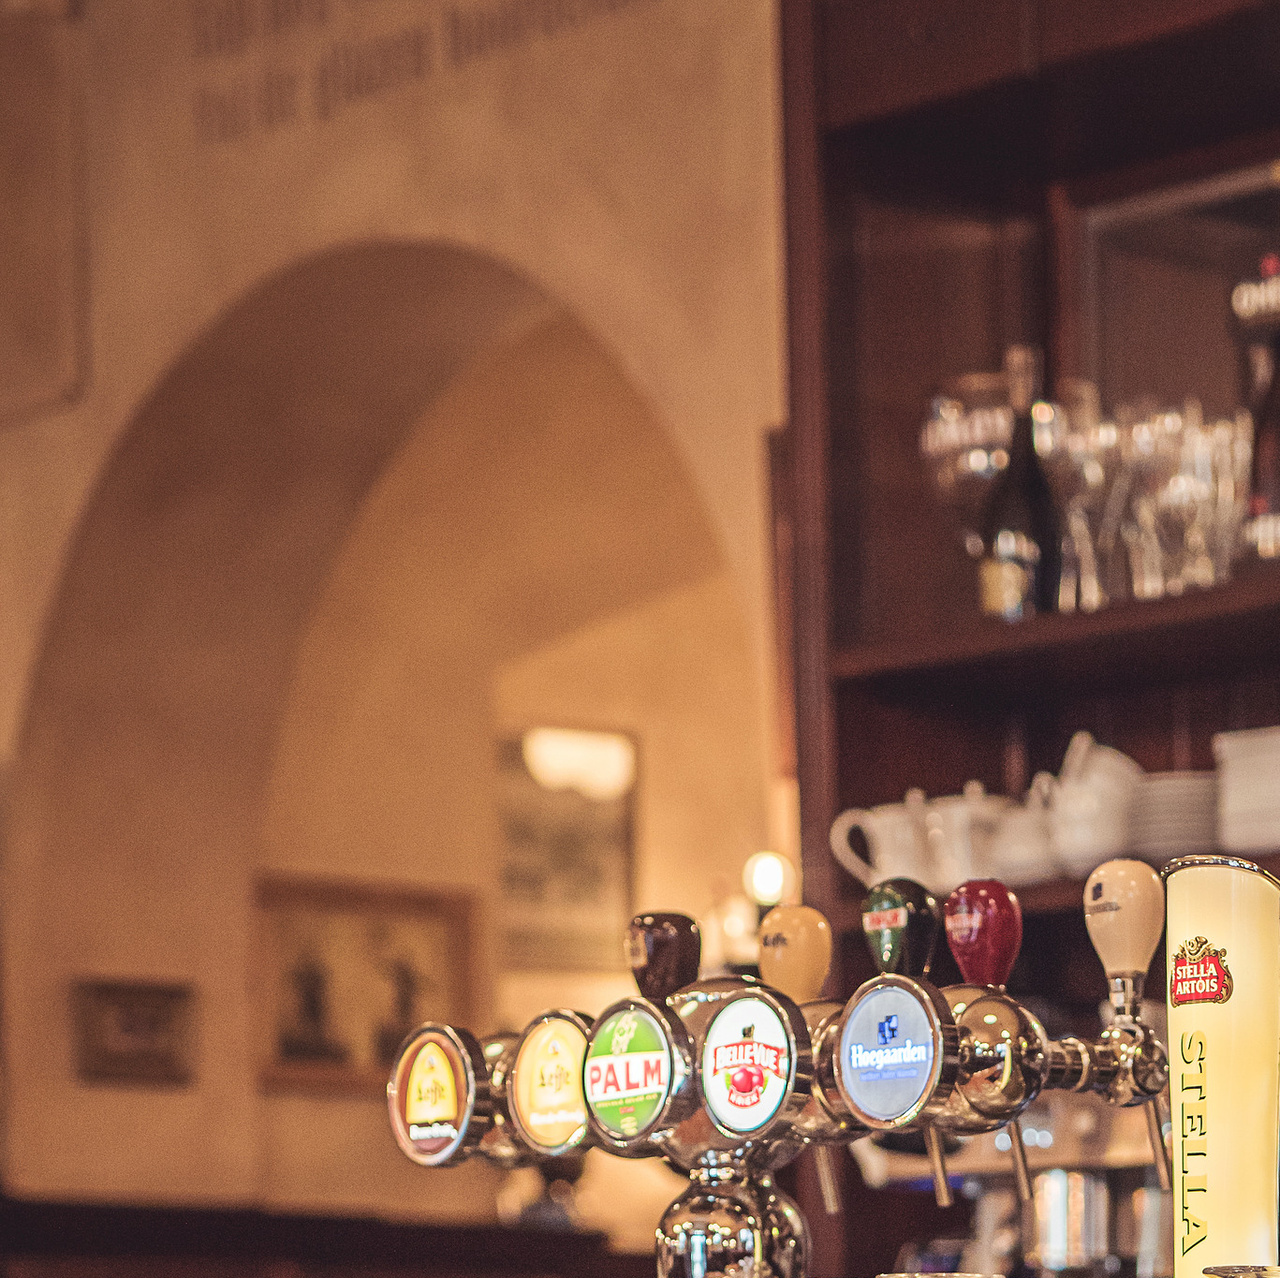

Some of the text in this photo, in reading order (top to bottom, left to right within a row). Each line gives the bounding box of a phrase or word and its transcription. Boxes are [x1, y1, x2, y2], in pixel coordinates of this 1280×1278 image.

[1176, 963, 1218, 980] STELLA
[1176, 978, 1219, 995] ARTOIS
[850, 1038, 927, 1070] Hoegaarden
[589, 1058, 664, 1097] PALM
[1181, 1030, 1208, 1258] STELLA
